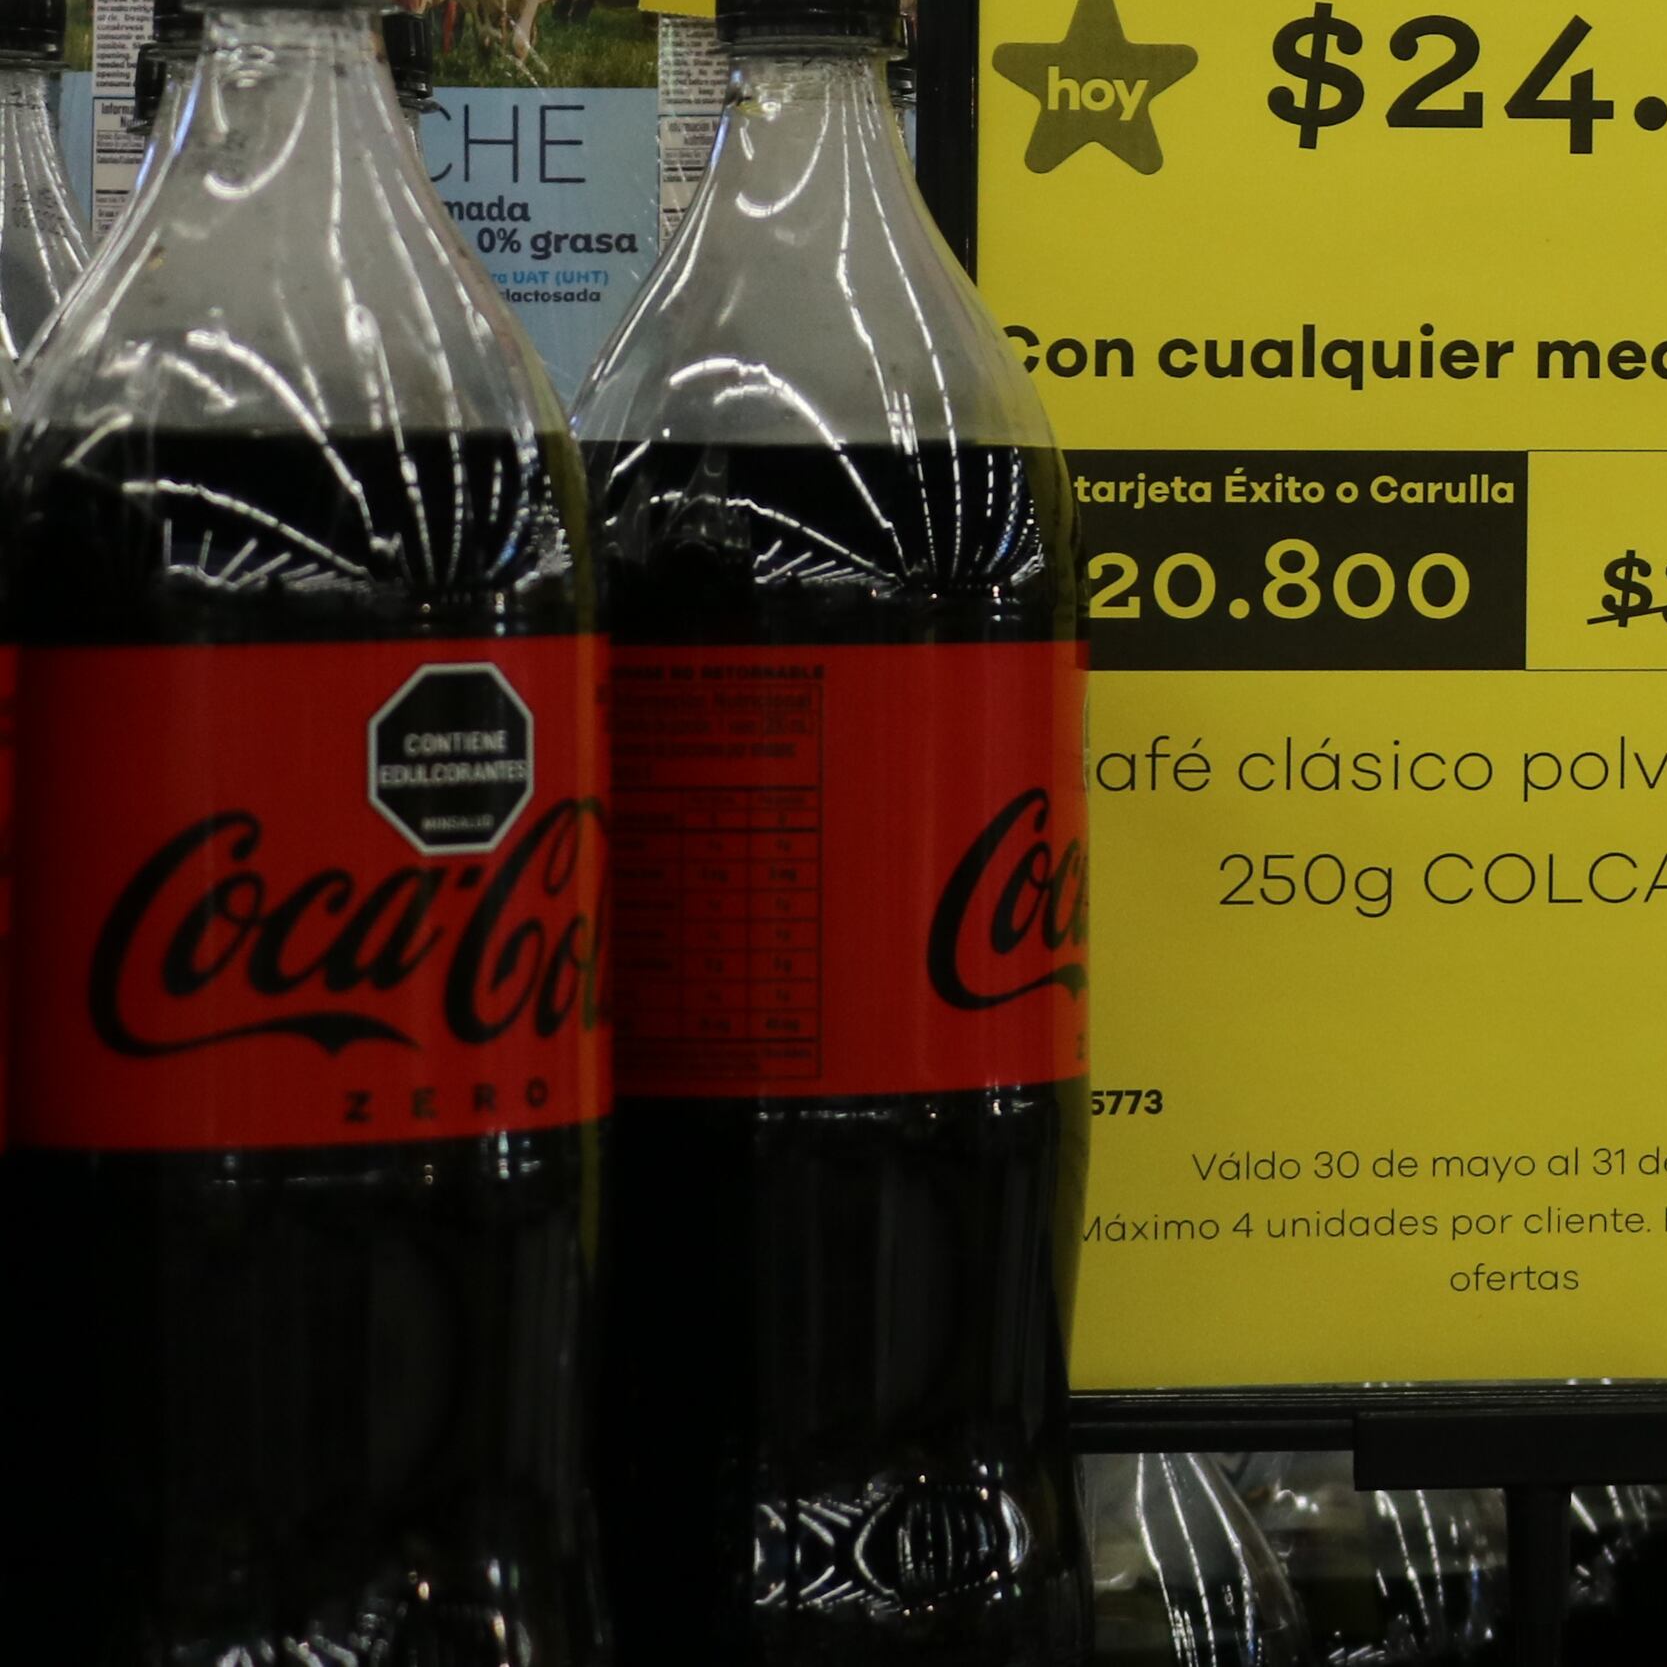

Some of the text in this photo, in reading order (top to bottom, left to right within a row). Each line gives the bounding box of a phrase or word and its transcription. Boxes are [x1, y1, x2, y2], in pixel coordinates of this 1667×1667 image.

[1047, 65, 1151, 123] hoy
[477, 227, 638, 261] 0% grasa
[503, 288, 601, 303] lactosada
[513, 270, 609, 287] UAT (UHT)
[1002, 325, 1134, 378] Con
[1158, 323, 1514, 391] cualquier
[1074, 467, 1514, 509] tarjeta Éxito o Carulla
[1088, 538, 1470, 620] 20.800
[403, 730, 507, 757] CONTIENE
[379, 759, 527, 786] EDULCORANTES
[1096, 735, 1211, 792] afé
[1238, 736, 1493, 792] clásico
[1219, 853, 1393, 919] 250g
[344, 1076, 551, 1124] ZERO
[1091, 1089, 1163, 1116] 5773
[1191, 1150, 1301, 1181] Váldo
[1313, 1150, 1360, 1179] 30
[1372, 1149, 1419, 1179] de
[1432, 1155, 1536, 1183] mayo
[1547, 1146, 1579, 1176] al
[1592, 1147, 1625, 1176] 31
[1232, 1212, 1254, 1239] 4
[1267, 1208, 1438, 1239] unidades
[1451, 1214, 1513, 1241] por
[1523, 1205, 1651, 1235] cliente.
[1450, 1262, 1579, 1292] ofertas
